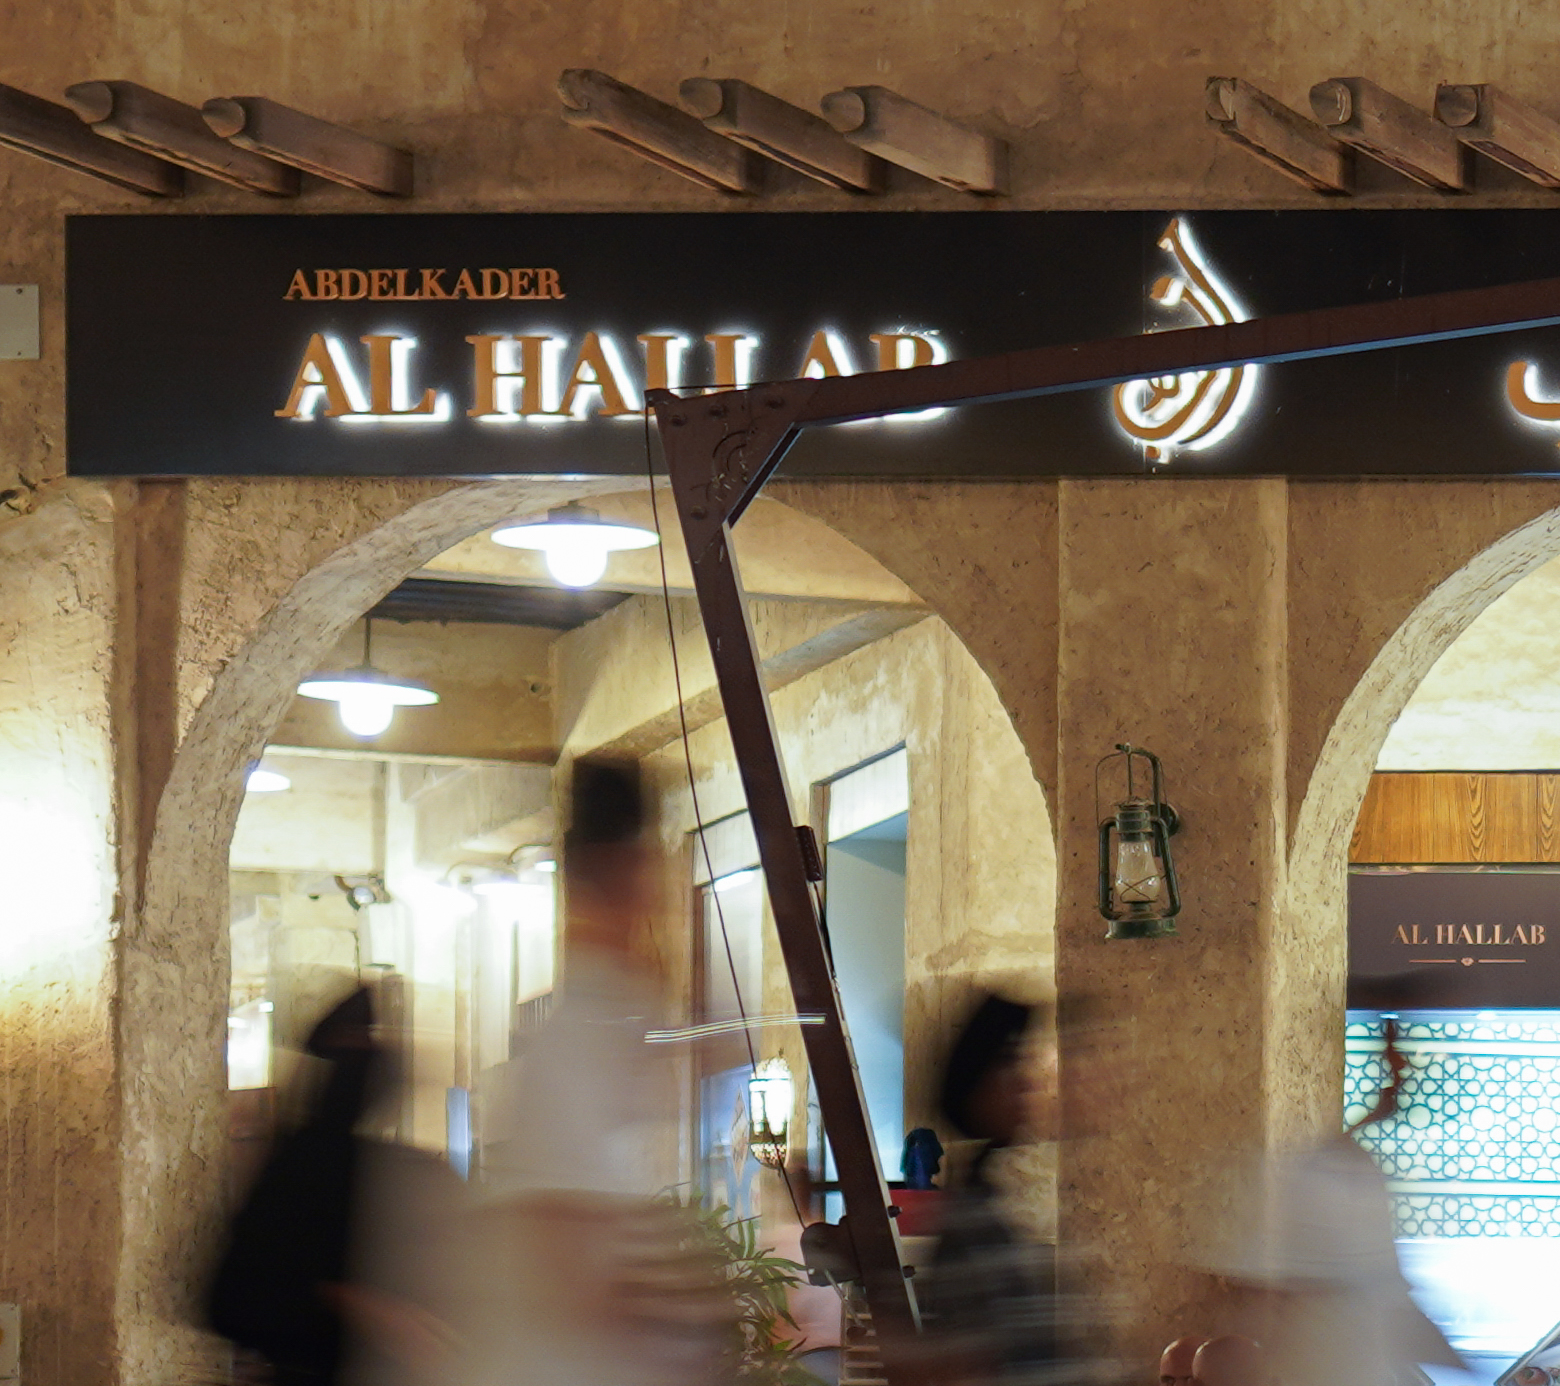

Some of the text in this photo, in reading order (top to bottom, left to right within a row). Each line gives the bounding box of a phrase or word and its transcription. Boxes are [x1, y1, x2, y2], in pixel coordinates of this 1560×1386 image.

[284, 267, 566, 301] ABDELKADER
[275, 331, 446, 419] AL
[1391, 923, 1546, 945] AL HALLAB
